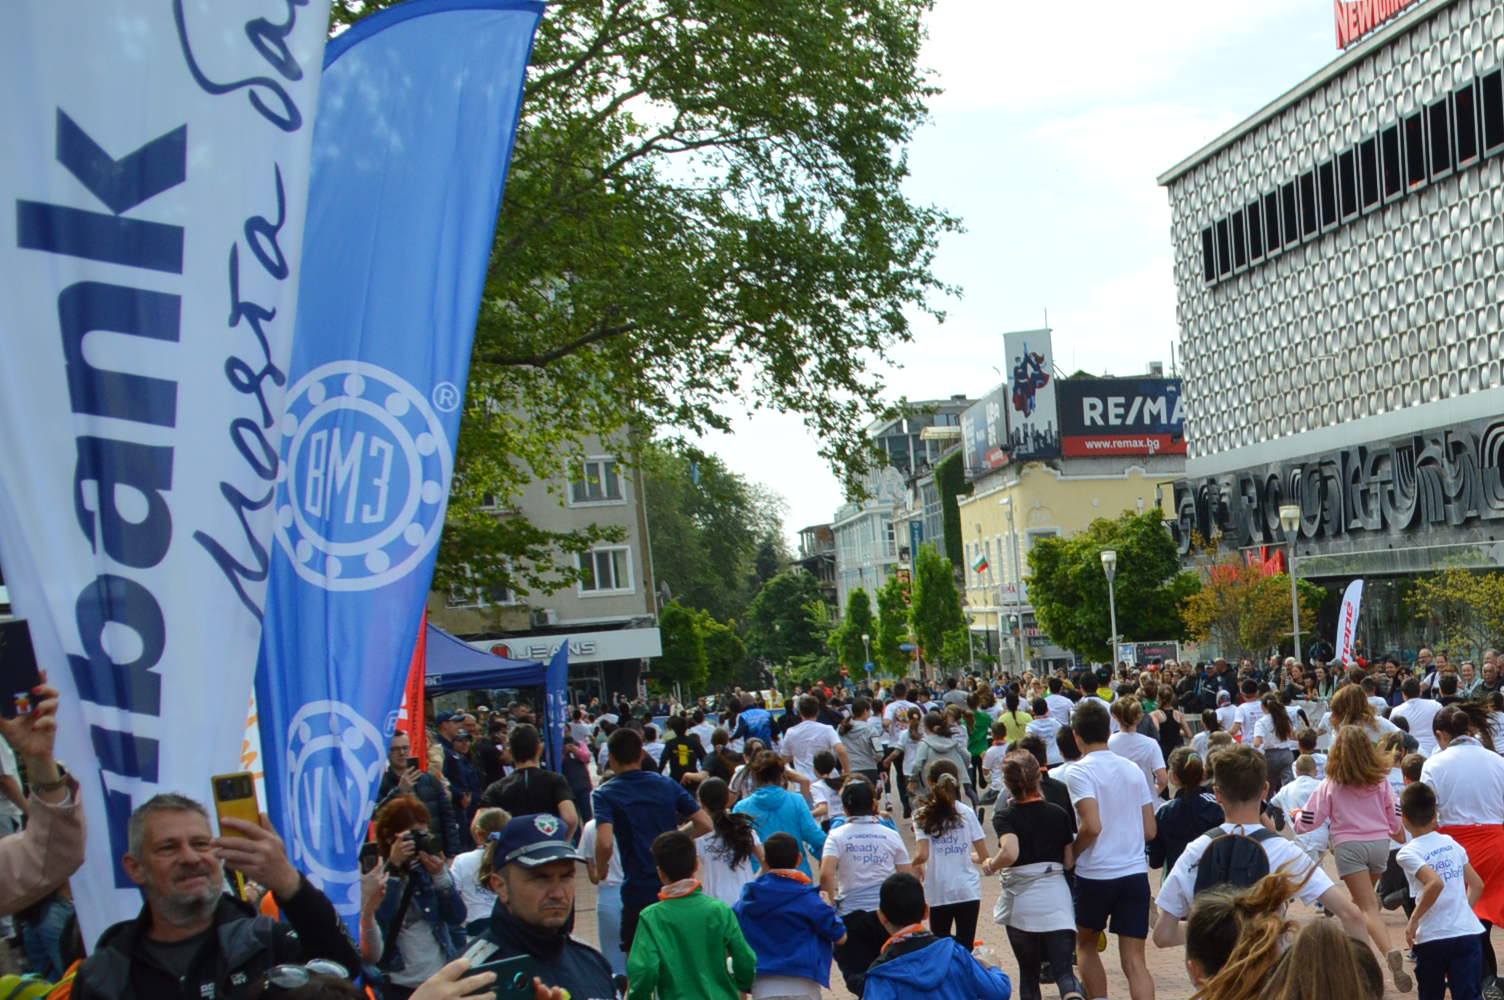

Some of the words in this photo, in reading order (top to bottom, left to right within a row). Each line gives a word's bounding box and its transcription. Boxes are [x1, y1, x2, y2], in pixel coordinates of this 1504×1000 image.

[1085, 438, 1160, 452] www.remax.bg
[933, 835, 959, 846] eady
[845, 843, 879, 854] Ready
[863, 854, 889, 865] play?
